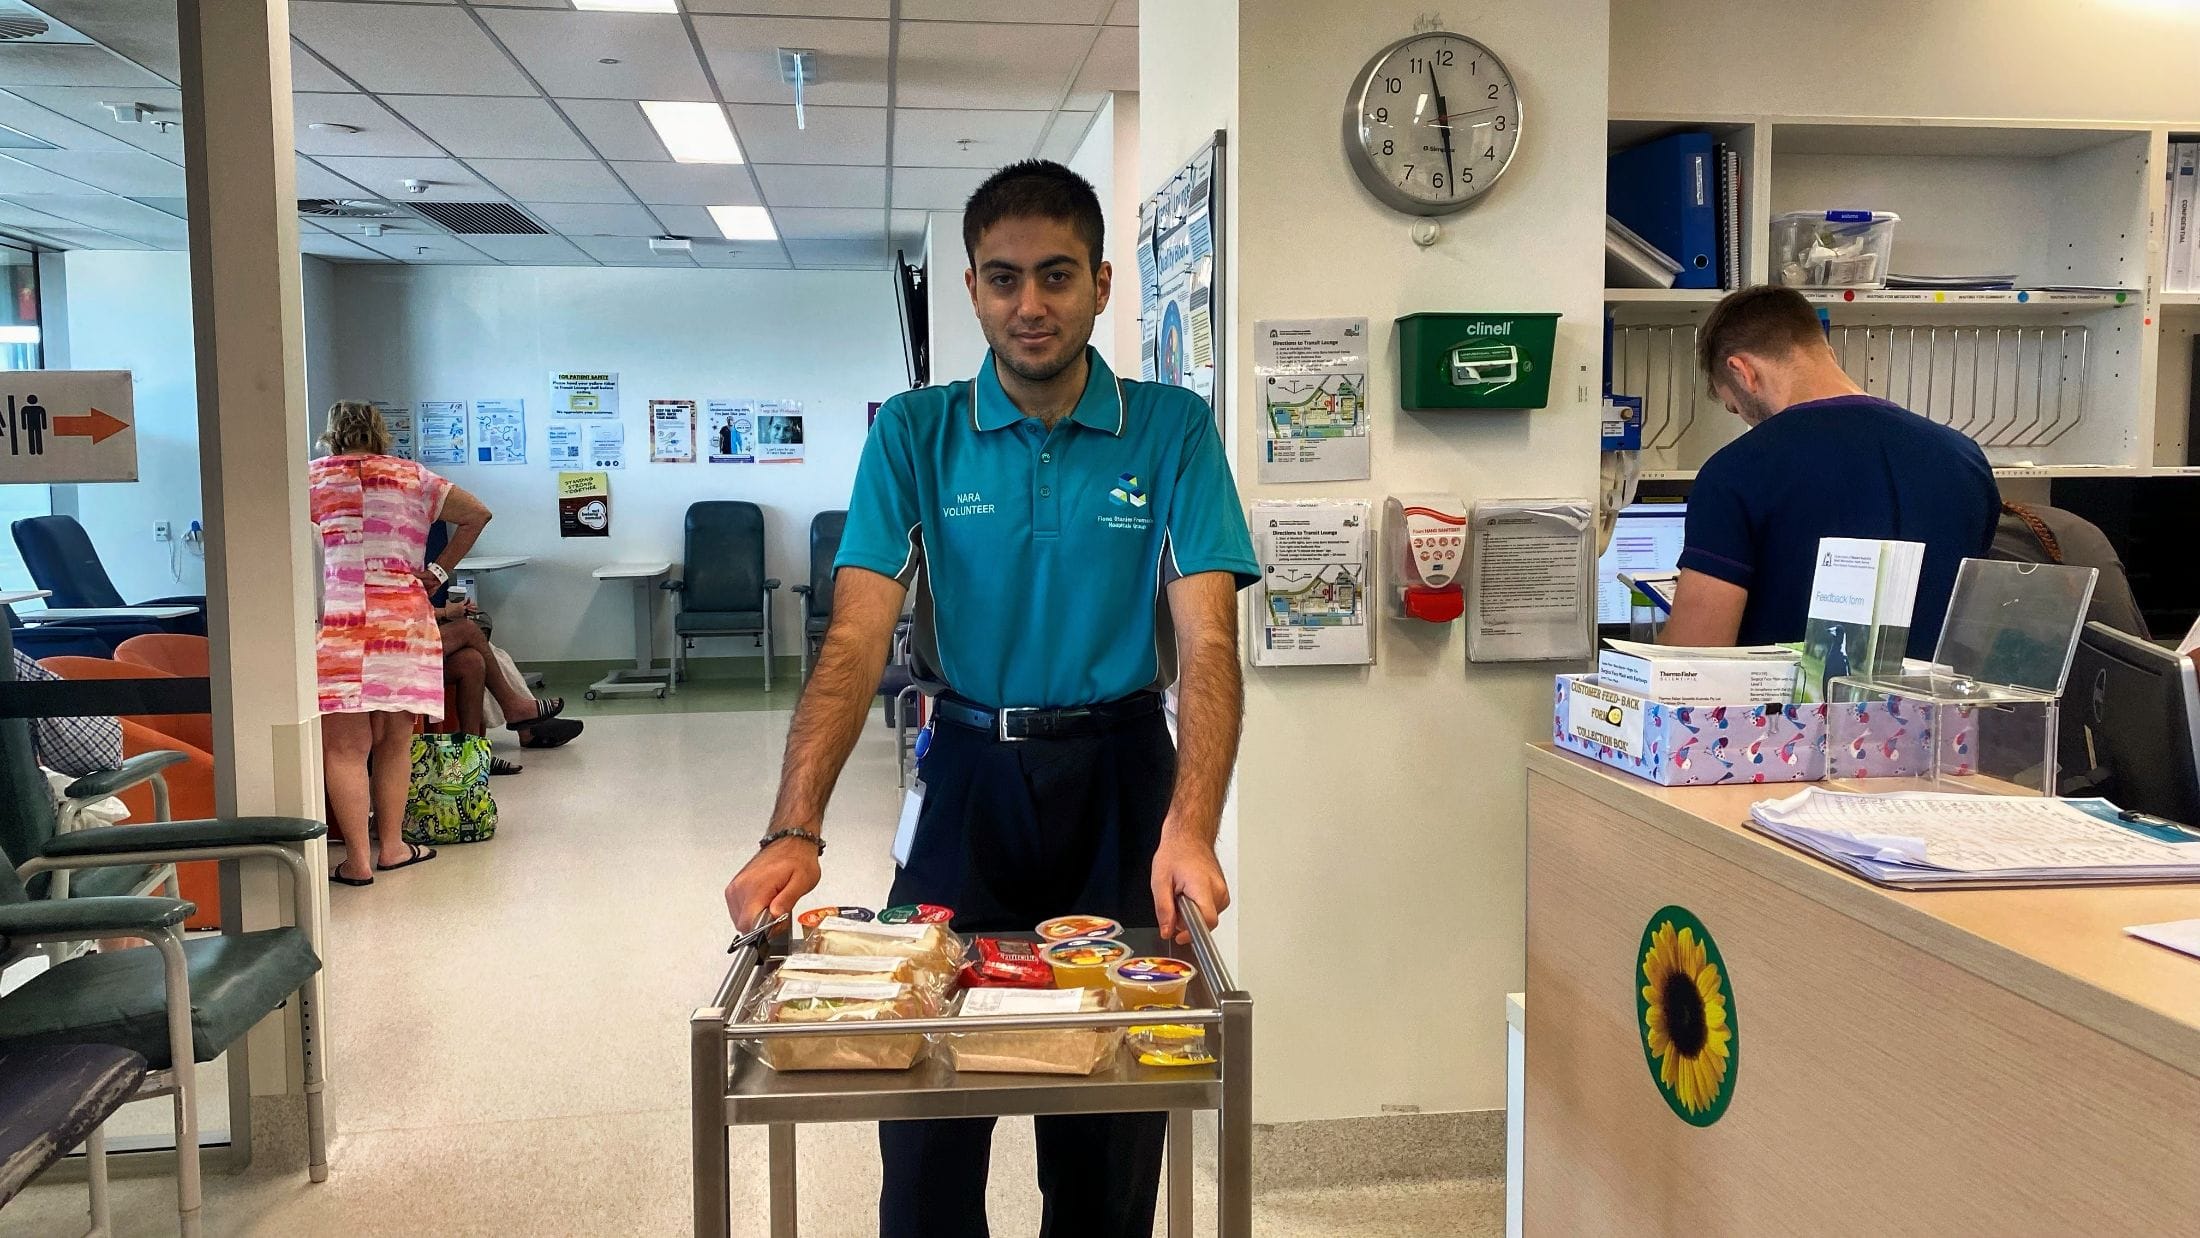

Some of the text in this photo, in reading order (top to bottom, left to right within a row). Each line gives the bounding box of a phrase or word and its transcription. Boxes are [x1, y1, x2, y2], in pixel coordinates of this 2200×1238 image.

[1410, 58, 1423, 74] 11
[1436, 50, 1454, 67] 12
[1471, 60, 1476, 76] 1
[1385, 77, 1402, 94] 10
[1487, 84, 1499, 100] 2
[1376, 107, 1388, 123] 9
[1494, 116, 1506, 132] 3
[1382, 139, 1394, 156] 8
[1484, 146, 1496, 161] 4
[1403, 164, 1415, 181] 7
[1432, 172, 1444, 189] 6
[1462, 167, 1474, 183] 5
[2179, 199, 2188, 243] CONFIDENTIAL
[1466, 321, 1512, 336] clinell
[957, 491, 981, 503] NARA
[942, 504, 995, 518] VOLUNTEER
[1816, 590, 1865, 607] Feedback form
[1571, 681, 1602, 700] CUSTOMER
[1621, 695, 1640, 711] BACK
